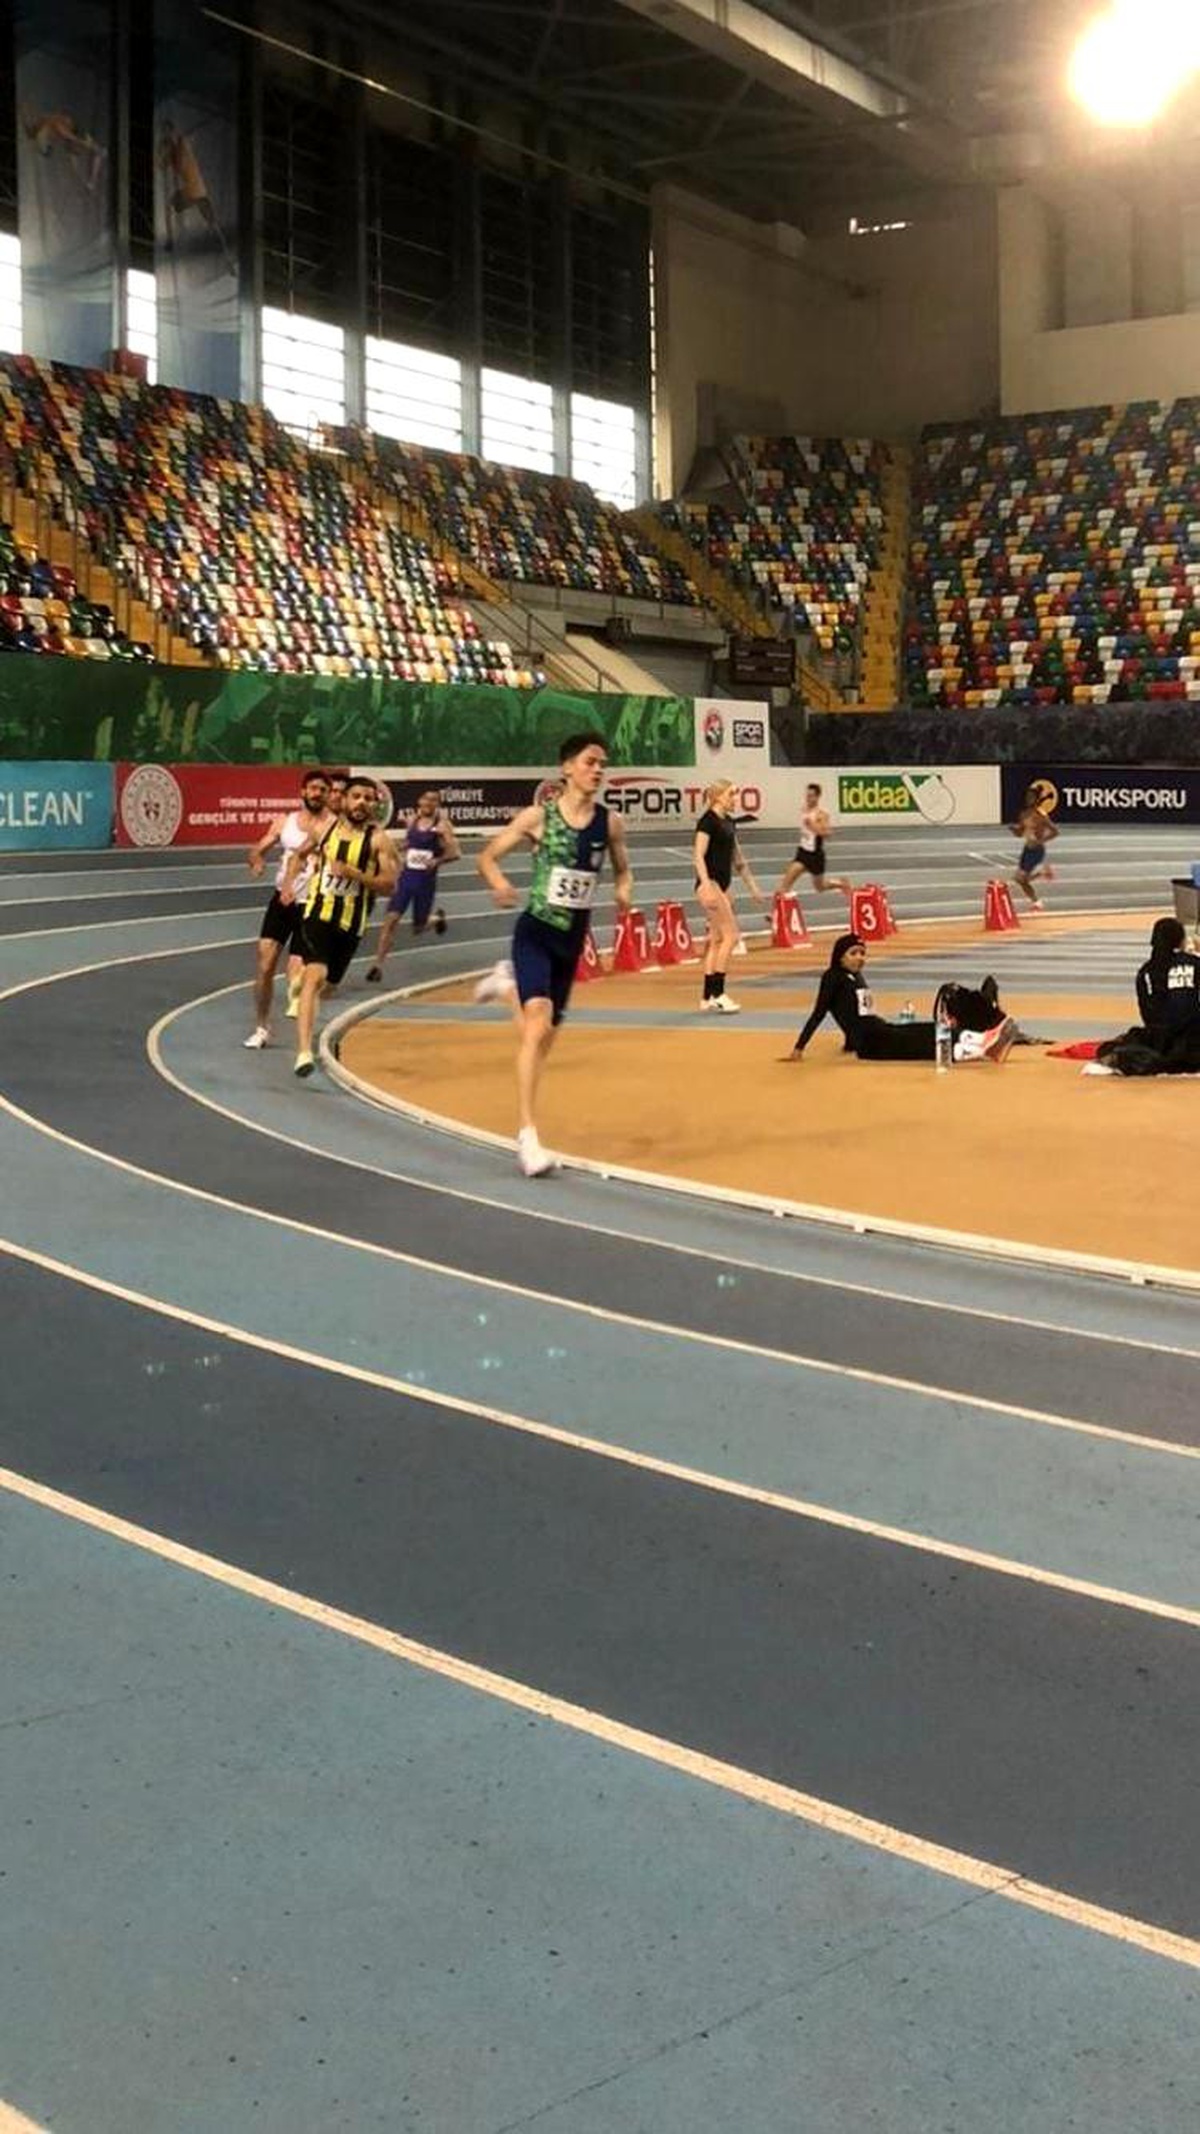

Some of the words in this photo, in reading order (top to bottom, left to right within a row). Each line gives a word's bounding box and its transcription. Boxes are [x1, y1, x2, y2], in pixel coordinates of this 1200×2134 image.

[842, 781, 909, 809] iddaa
[1063, 787, 1186, 808] TURKSPORU
[556, 878, 590, 899] 587
[790, 908, 804, 935] 4
[861, 903, 877, 931] 3
[634, 926, 647, 959] 7
[675, 920, 690, 950] 6
